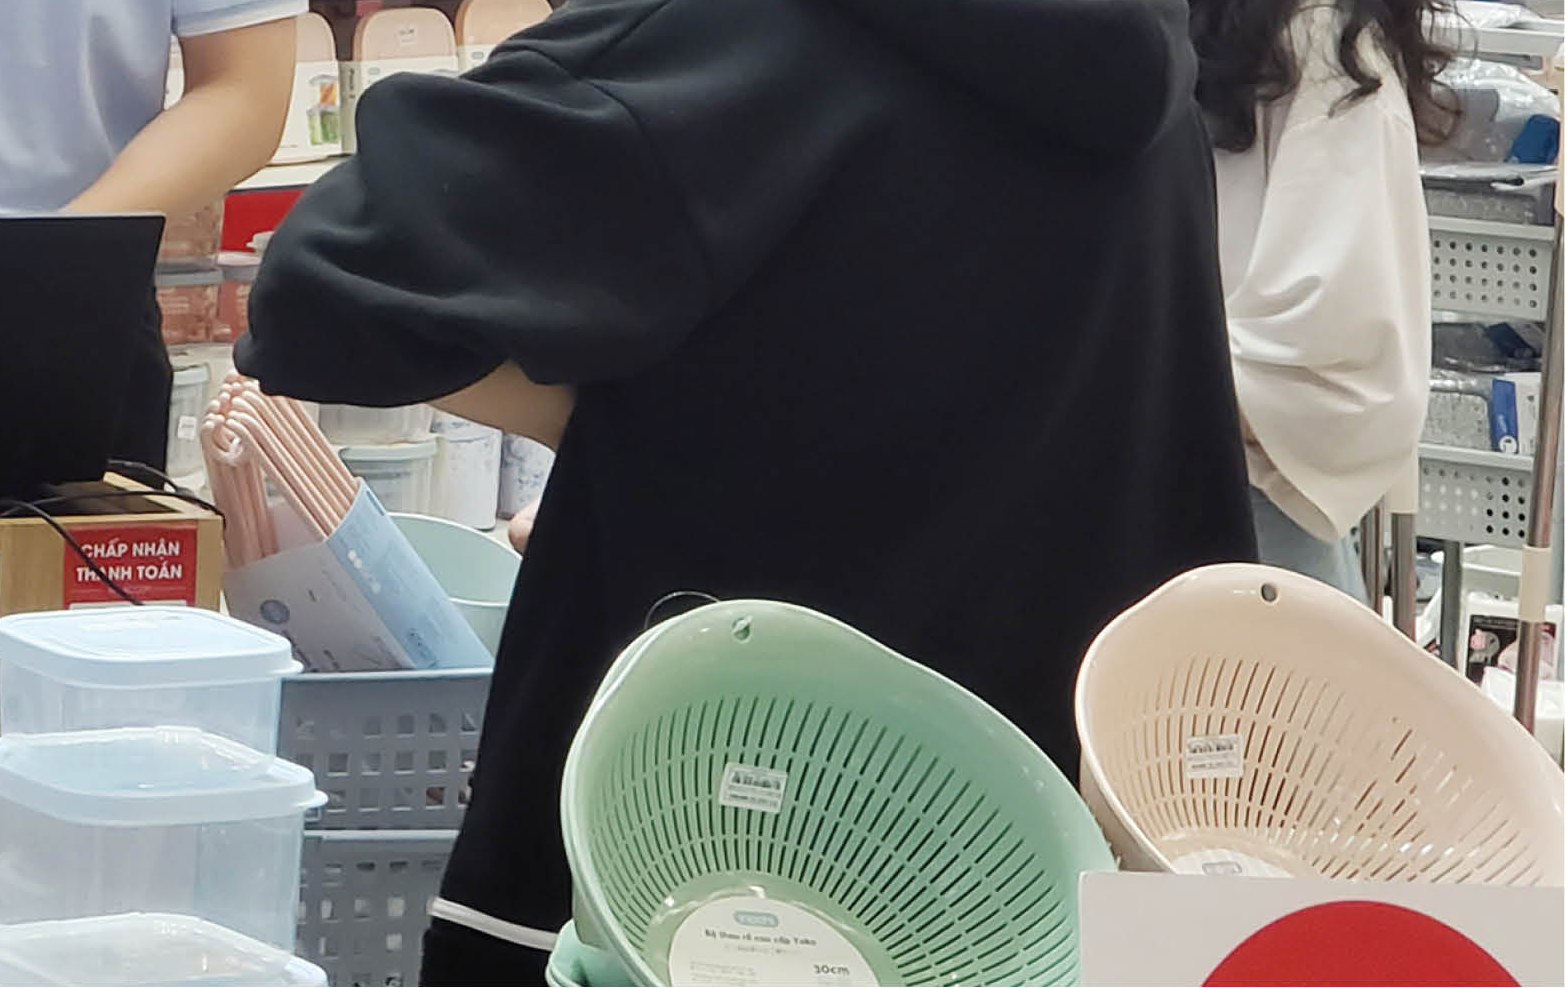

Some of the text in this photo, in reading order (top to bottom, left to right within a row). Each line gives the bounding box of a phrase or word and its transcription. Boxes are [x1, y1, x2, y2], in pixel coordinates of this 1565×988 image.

[81, 537, 180, 560] CHẤP NHẬN
[77, 561, 182, 581] THNH TOÁN
